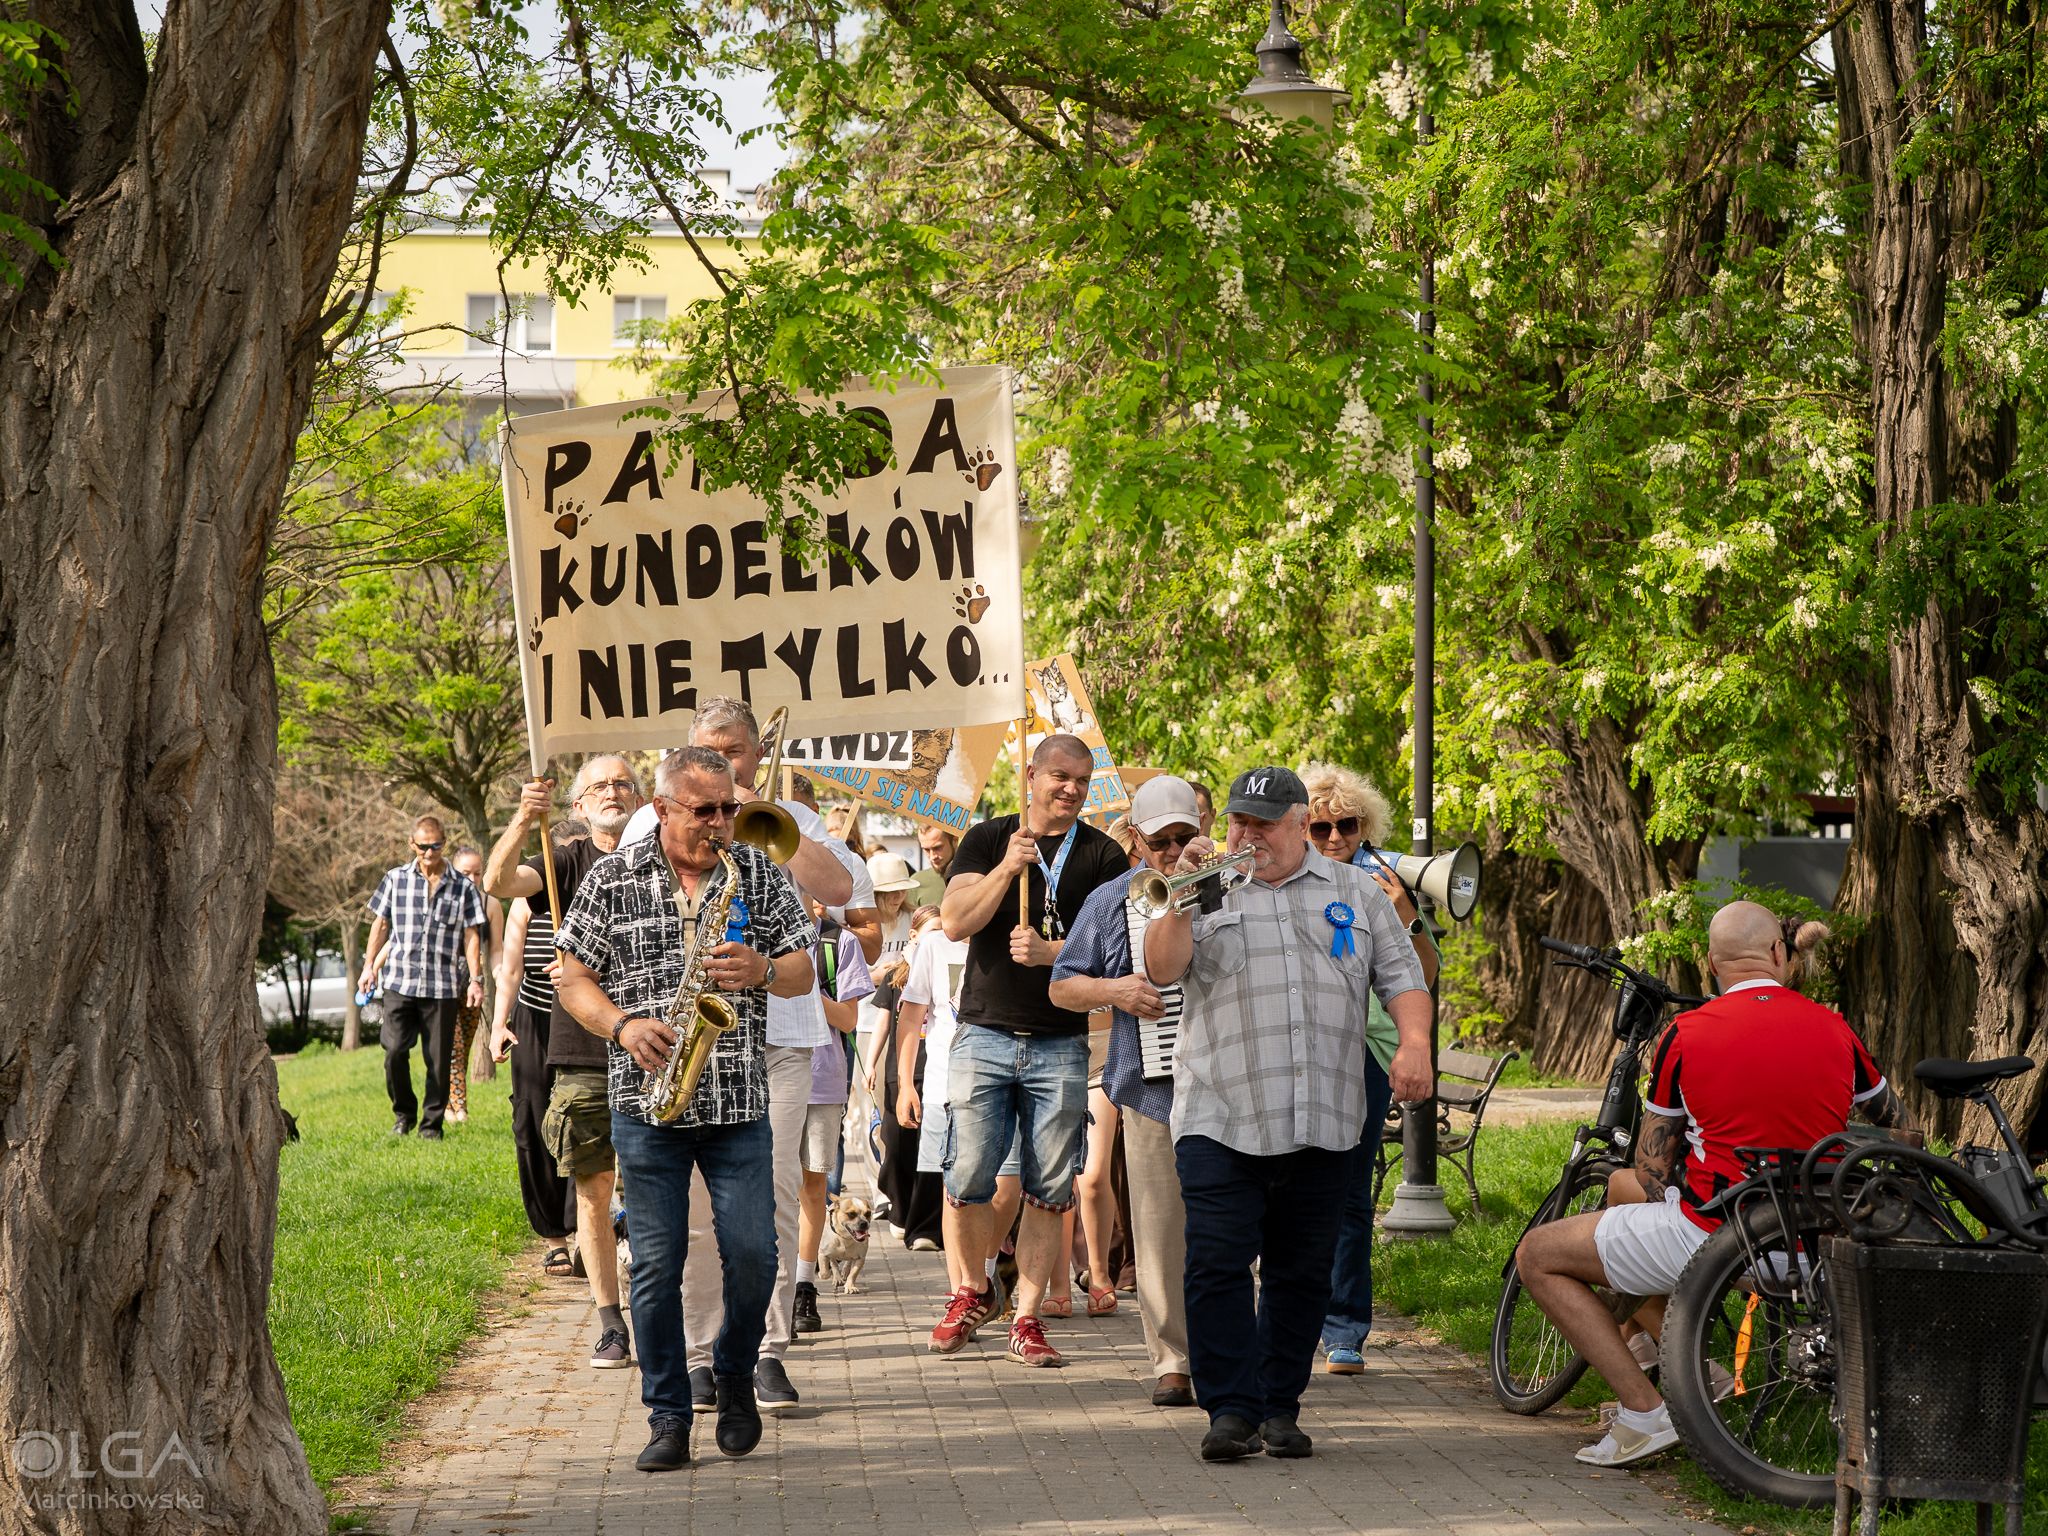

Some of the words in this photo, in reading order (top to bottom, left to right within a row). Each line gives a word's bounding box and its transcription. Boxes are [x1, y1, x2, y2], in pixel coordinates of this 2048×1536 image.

[544, 398, 970, 513] PADA
[540, 486, 976, 624] KUNDELKÓW
[542, 653, 554, 727] I
[579, 639, 698, 720] NIE
[873, 777, 908, 809] SIĘ
[907, 789, 970, 831] NAMI
[1245, 776, 1270, 796] M
